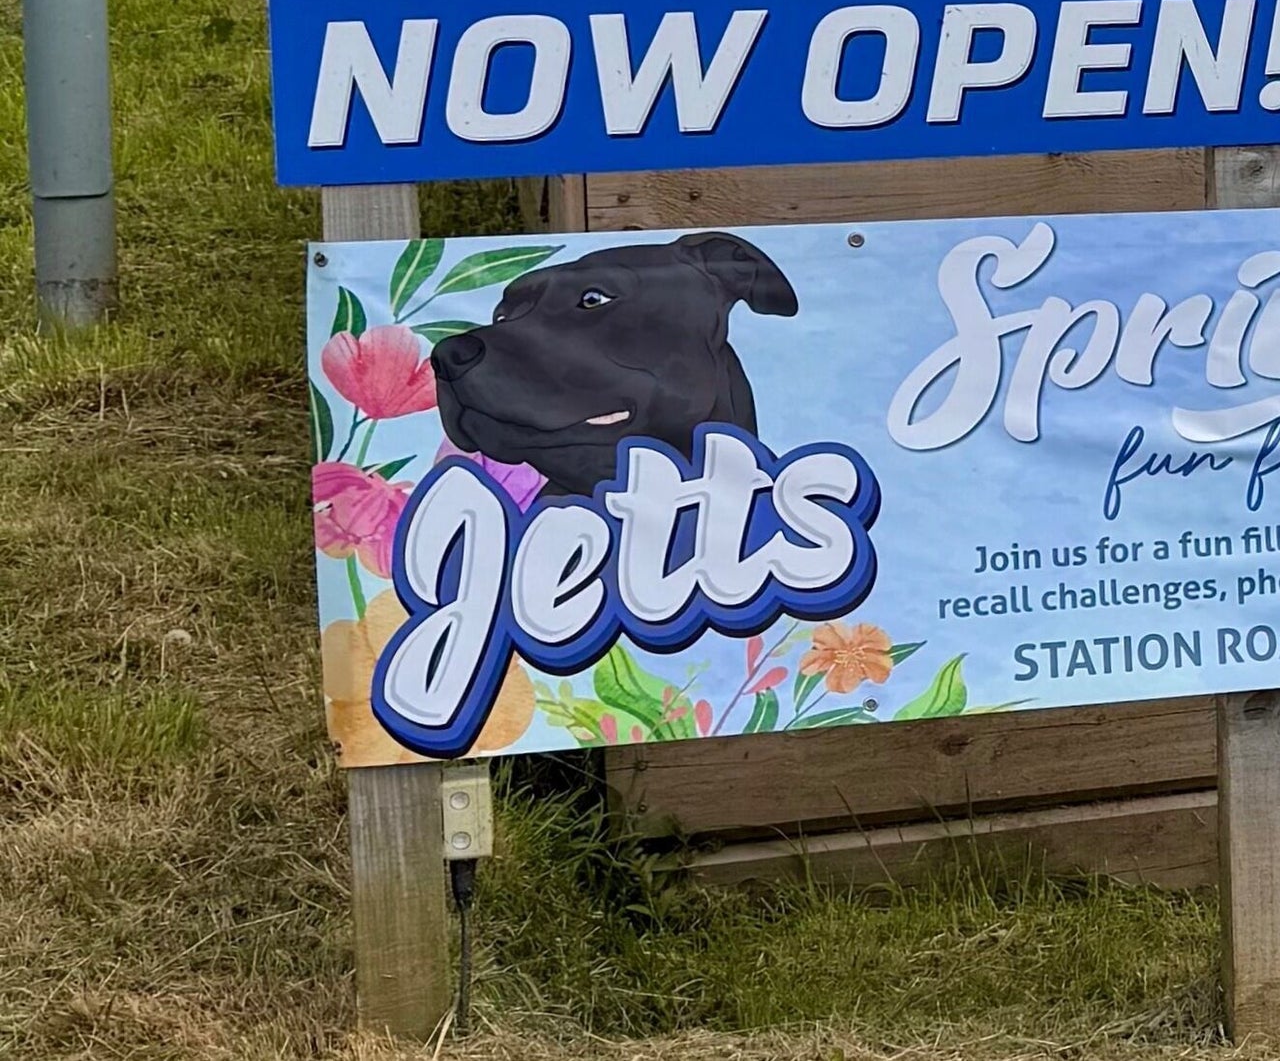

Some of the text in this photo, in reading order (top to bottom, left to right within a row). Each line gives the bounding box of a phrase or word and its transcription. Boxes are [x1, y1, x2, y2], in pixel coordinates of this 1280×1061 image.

[307, 8, 768, 148] NOW
[1103, 425, 1235, 520] fun
[383, 431, 857, 728] Jetts
[974, 544, 1041, 574] Join
[1052, 545, 1087, 568] us
[1098, 536, 1144, 564] for
[1153, 541, 1170, 561] a
[1178, 530, 1233, 558] fun
[938, 586, 1033, 619] recall
[1041, 577, 1227, 611] challenges,
[1014, 629, 1201, 681] STATION
